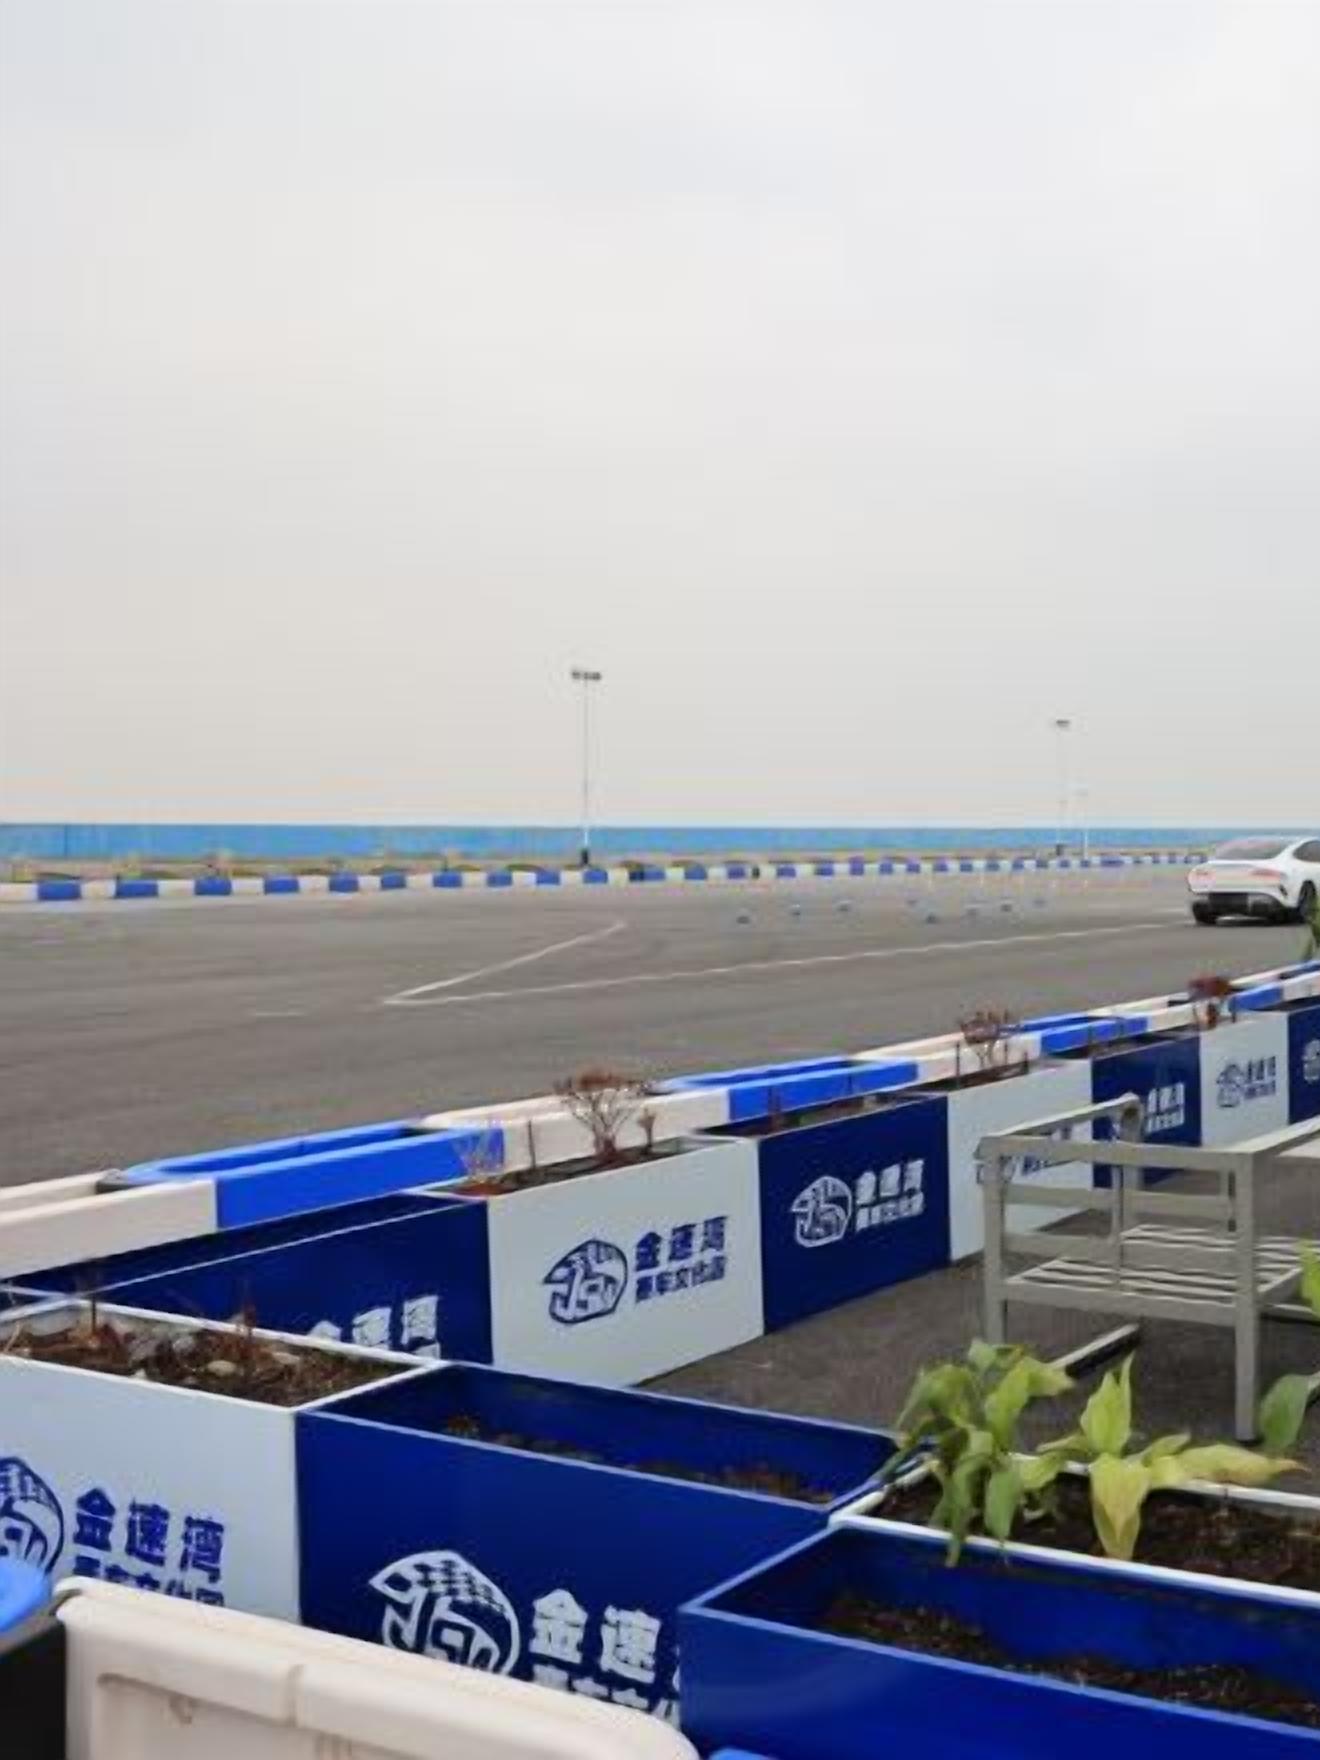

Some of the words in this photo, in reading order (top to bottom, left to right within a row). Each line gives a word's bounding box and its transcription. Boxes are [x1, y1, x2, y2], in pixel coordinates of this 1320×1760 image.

[635, 1215, 729, 1272] 金速湾
[73, 1487, 225, 1584] 金速湾
[529, 1588, 681, 1692] 金速
